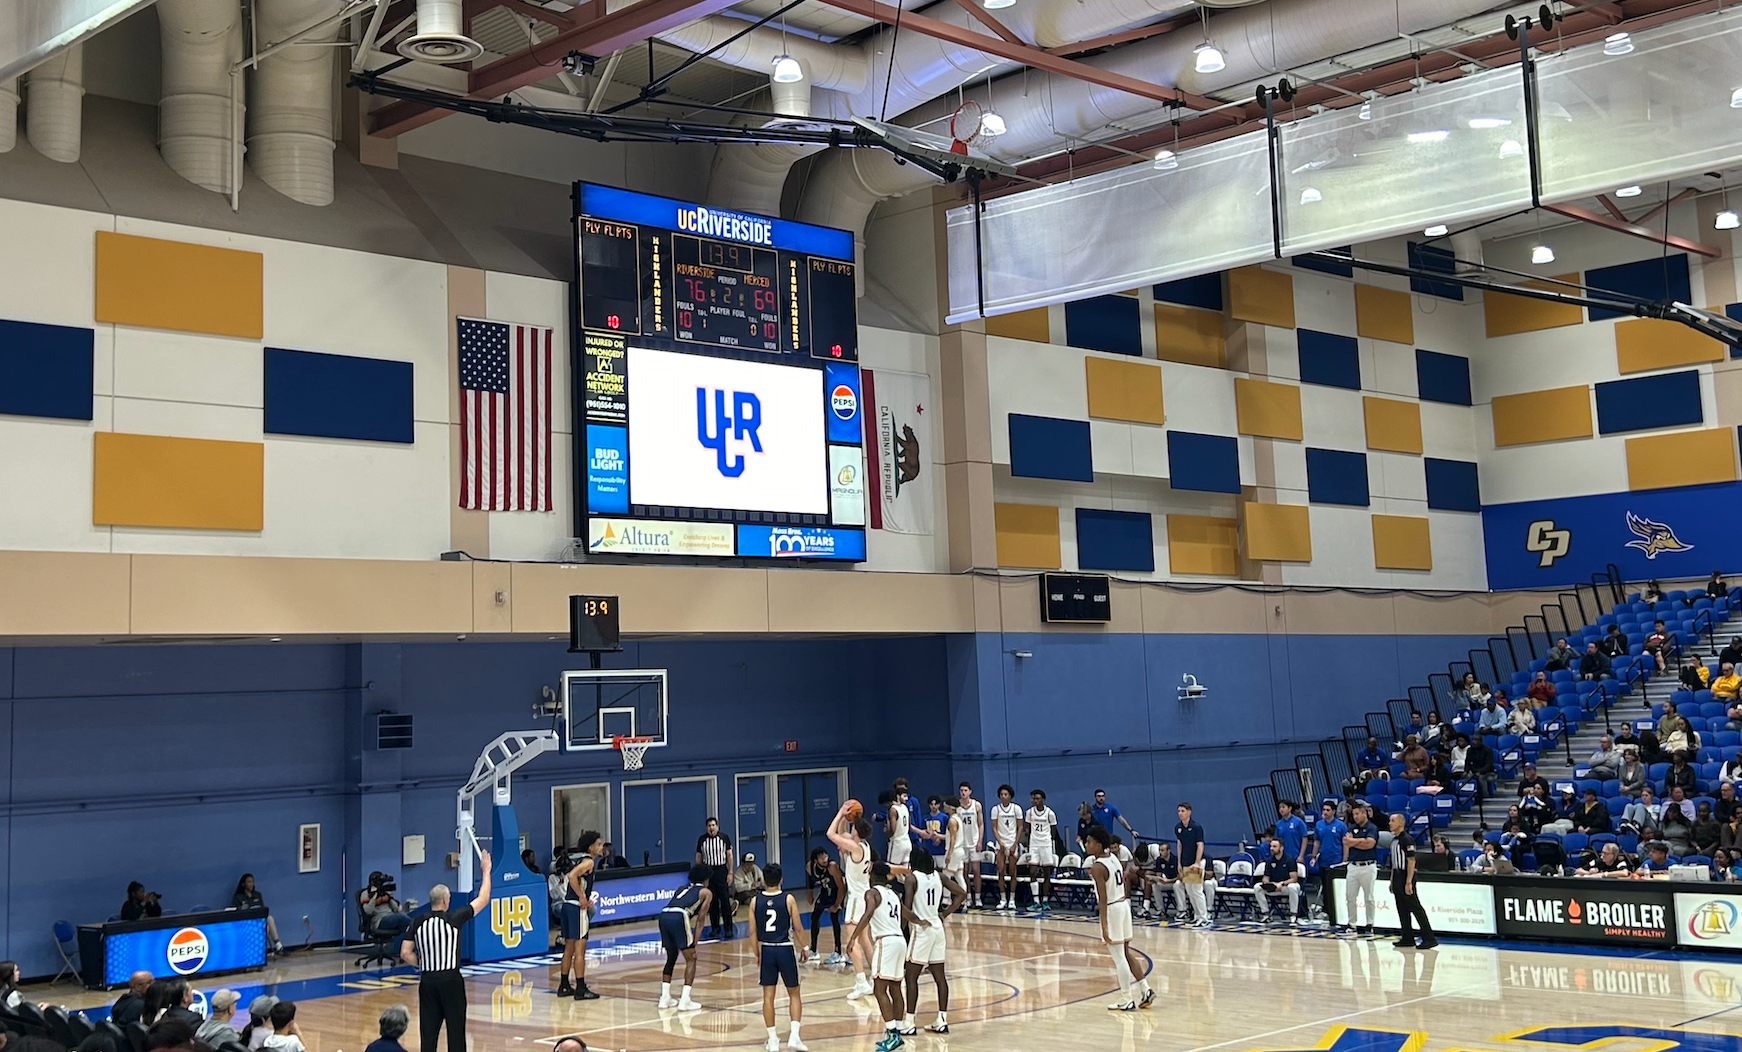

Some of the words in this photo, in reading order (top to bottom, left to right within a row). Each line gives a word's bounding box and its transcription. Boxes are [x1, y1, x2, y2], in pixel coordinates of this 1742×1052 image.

[709, 209, 736, 219] UNIVERSITY
[744, 215, 771, 225] CALIFORNIA
[585, 221, 600, 233] PLY
[604, 225, 614, 236] FL
[616, 226, 632, 240] PTS
[709, 244, 739, 266] 13.9
[677, 263, 715, 279] RIVERSIDE
[813, 261, 826, 272] PLY
[828, 265, 836, 274] FL
[838, 265, 852, 276] PTS
[717, 275, 737, 286] PERIOD
[743, 274, 770, 288] MERCED
[685, 278, 705, 302] 76
[723, 287, 732, 304] 2
[677, 301, 695, 311] FOULS
[753, 289, 775, 311] 69
[710, 306, 730, 316] PLAYER
[732, 309, 746, 318] FOUL
[761, 313, 778, 323] FOULS
[607, 315, 620, 329] 10
[679, 311, 692, 328] 10
[702, 318, 707, 328] 1
[679, 330, 693, 339] WON
[750, 323, 757, 336] 0
[763, 322, 776, 339] 10
[585, 336, 613, 348] INJURED
[614, 340, 624, 349] OR
[719, 335, 739, 345] MATCH
[764, 341, 777, 350] WON
[585, 346, 625, 359] WRONGED?
[831, 344, 843, 358] 10
[586, 371, 625, 384] ACCIDENT
[586, 380, 625, 393] NETWORK
[833, 397, 855, 407] PEPSI
[880, 405, 890, 456] CALIFORNIA
[595, 447, 620, 460] BUD
[590, 457, 625, 471] LIGHT
[589, 474, 627, 486] Responsibility
[597, 484, 619, 493] Matters
[620, 525, 670, 546] Altura
[804, 535, 835, 547] YEARS
[769, 534, 806, 557] 100
[584, 600, 608, 616] 13.9
[1004, 819, 1010, 828] 4
[1035, 823, 1043, 833] 21
[600, 893, 656, 908] Northwestern
[926, 888, 935, 906] 11
[887, 901, 898, 921] 24
[1437, 906, 1466, 914] Riverside
[1466, 907, 1483, 915] Plaza
[1503, 897, 1565, 924] FLAME
[1586, 901, 1666, 929] BROILER
[765, 908, 777, 932] 2
[1604, 927, 1631, 937] SIMPLY
[1632, 929, 1666, 938] HEALTHY
[171, 944, 205, 957] PEPSI
